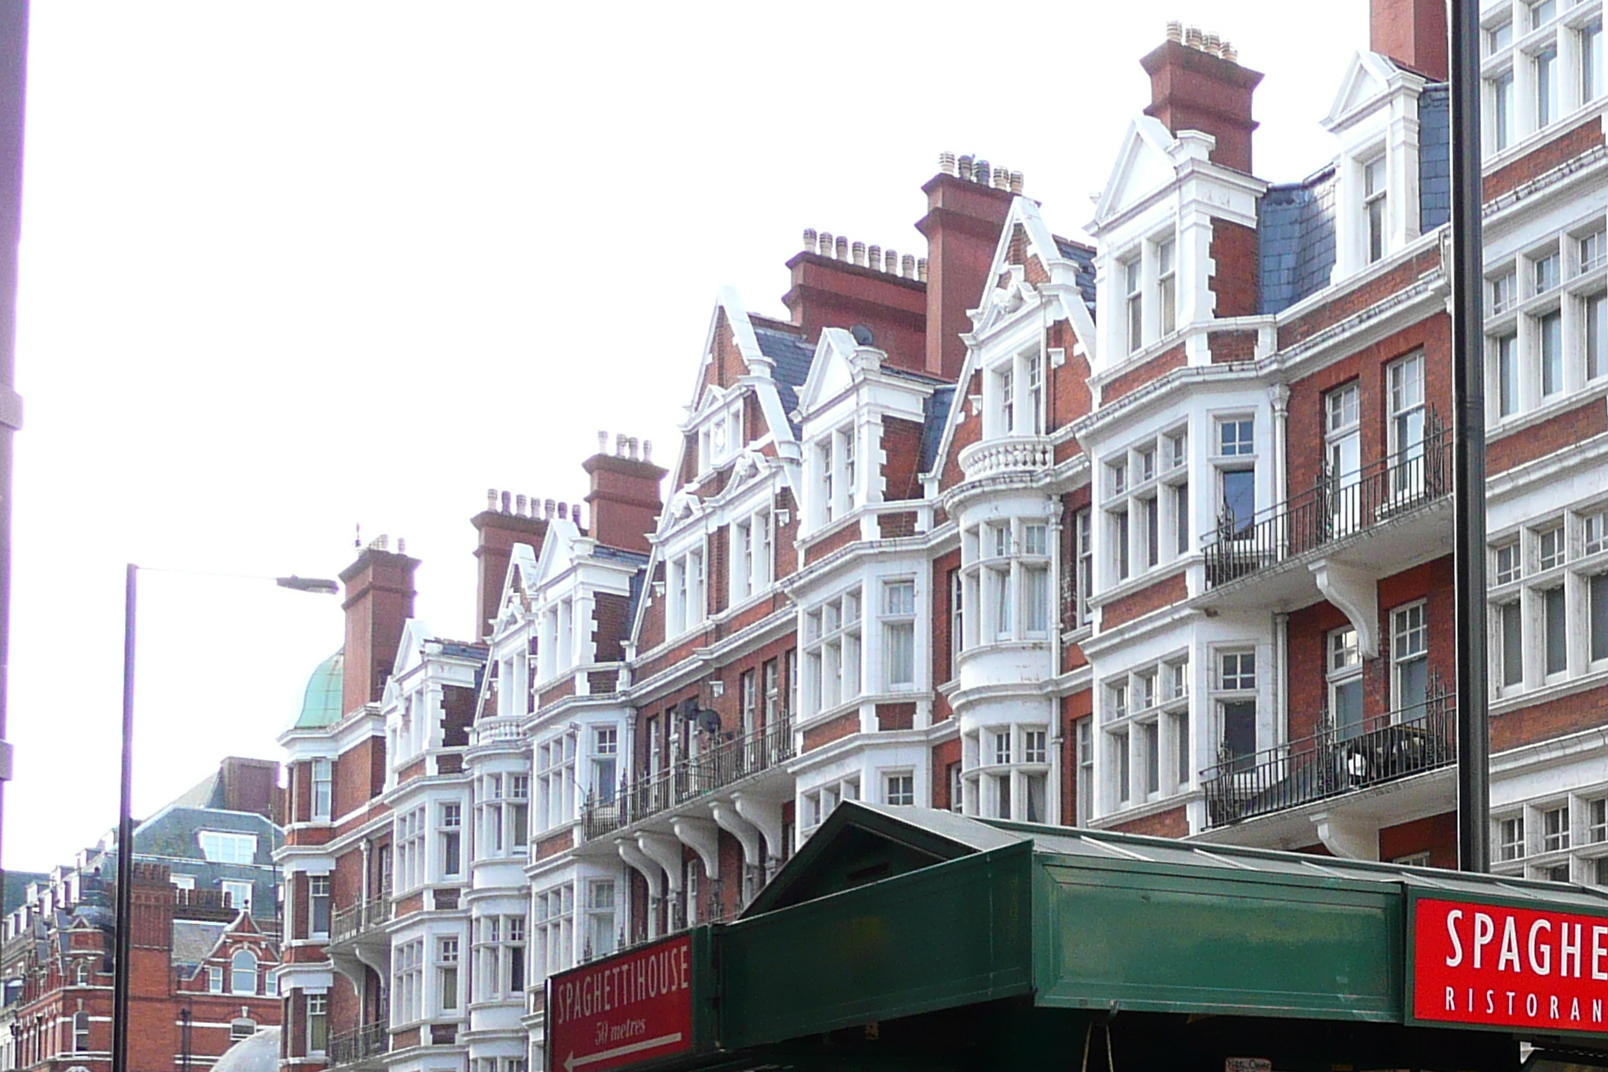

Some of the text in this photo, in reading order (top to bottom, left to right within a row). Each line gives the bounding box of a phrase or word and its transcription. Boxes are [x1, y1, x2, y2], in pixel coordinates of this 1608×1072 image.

[558, 946, 688, 1024] SPAGHETTIHOUSE
[595, 1018, 646, 1045] 50 metres
